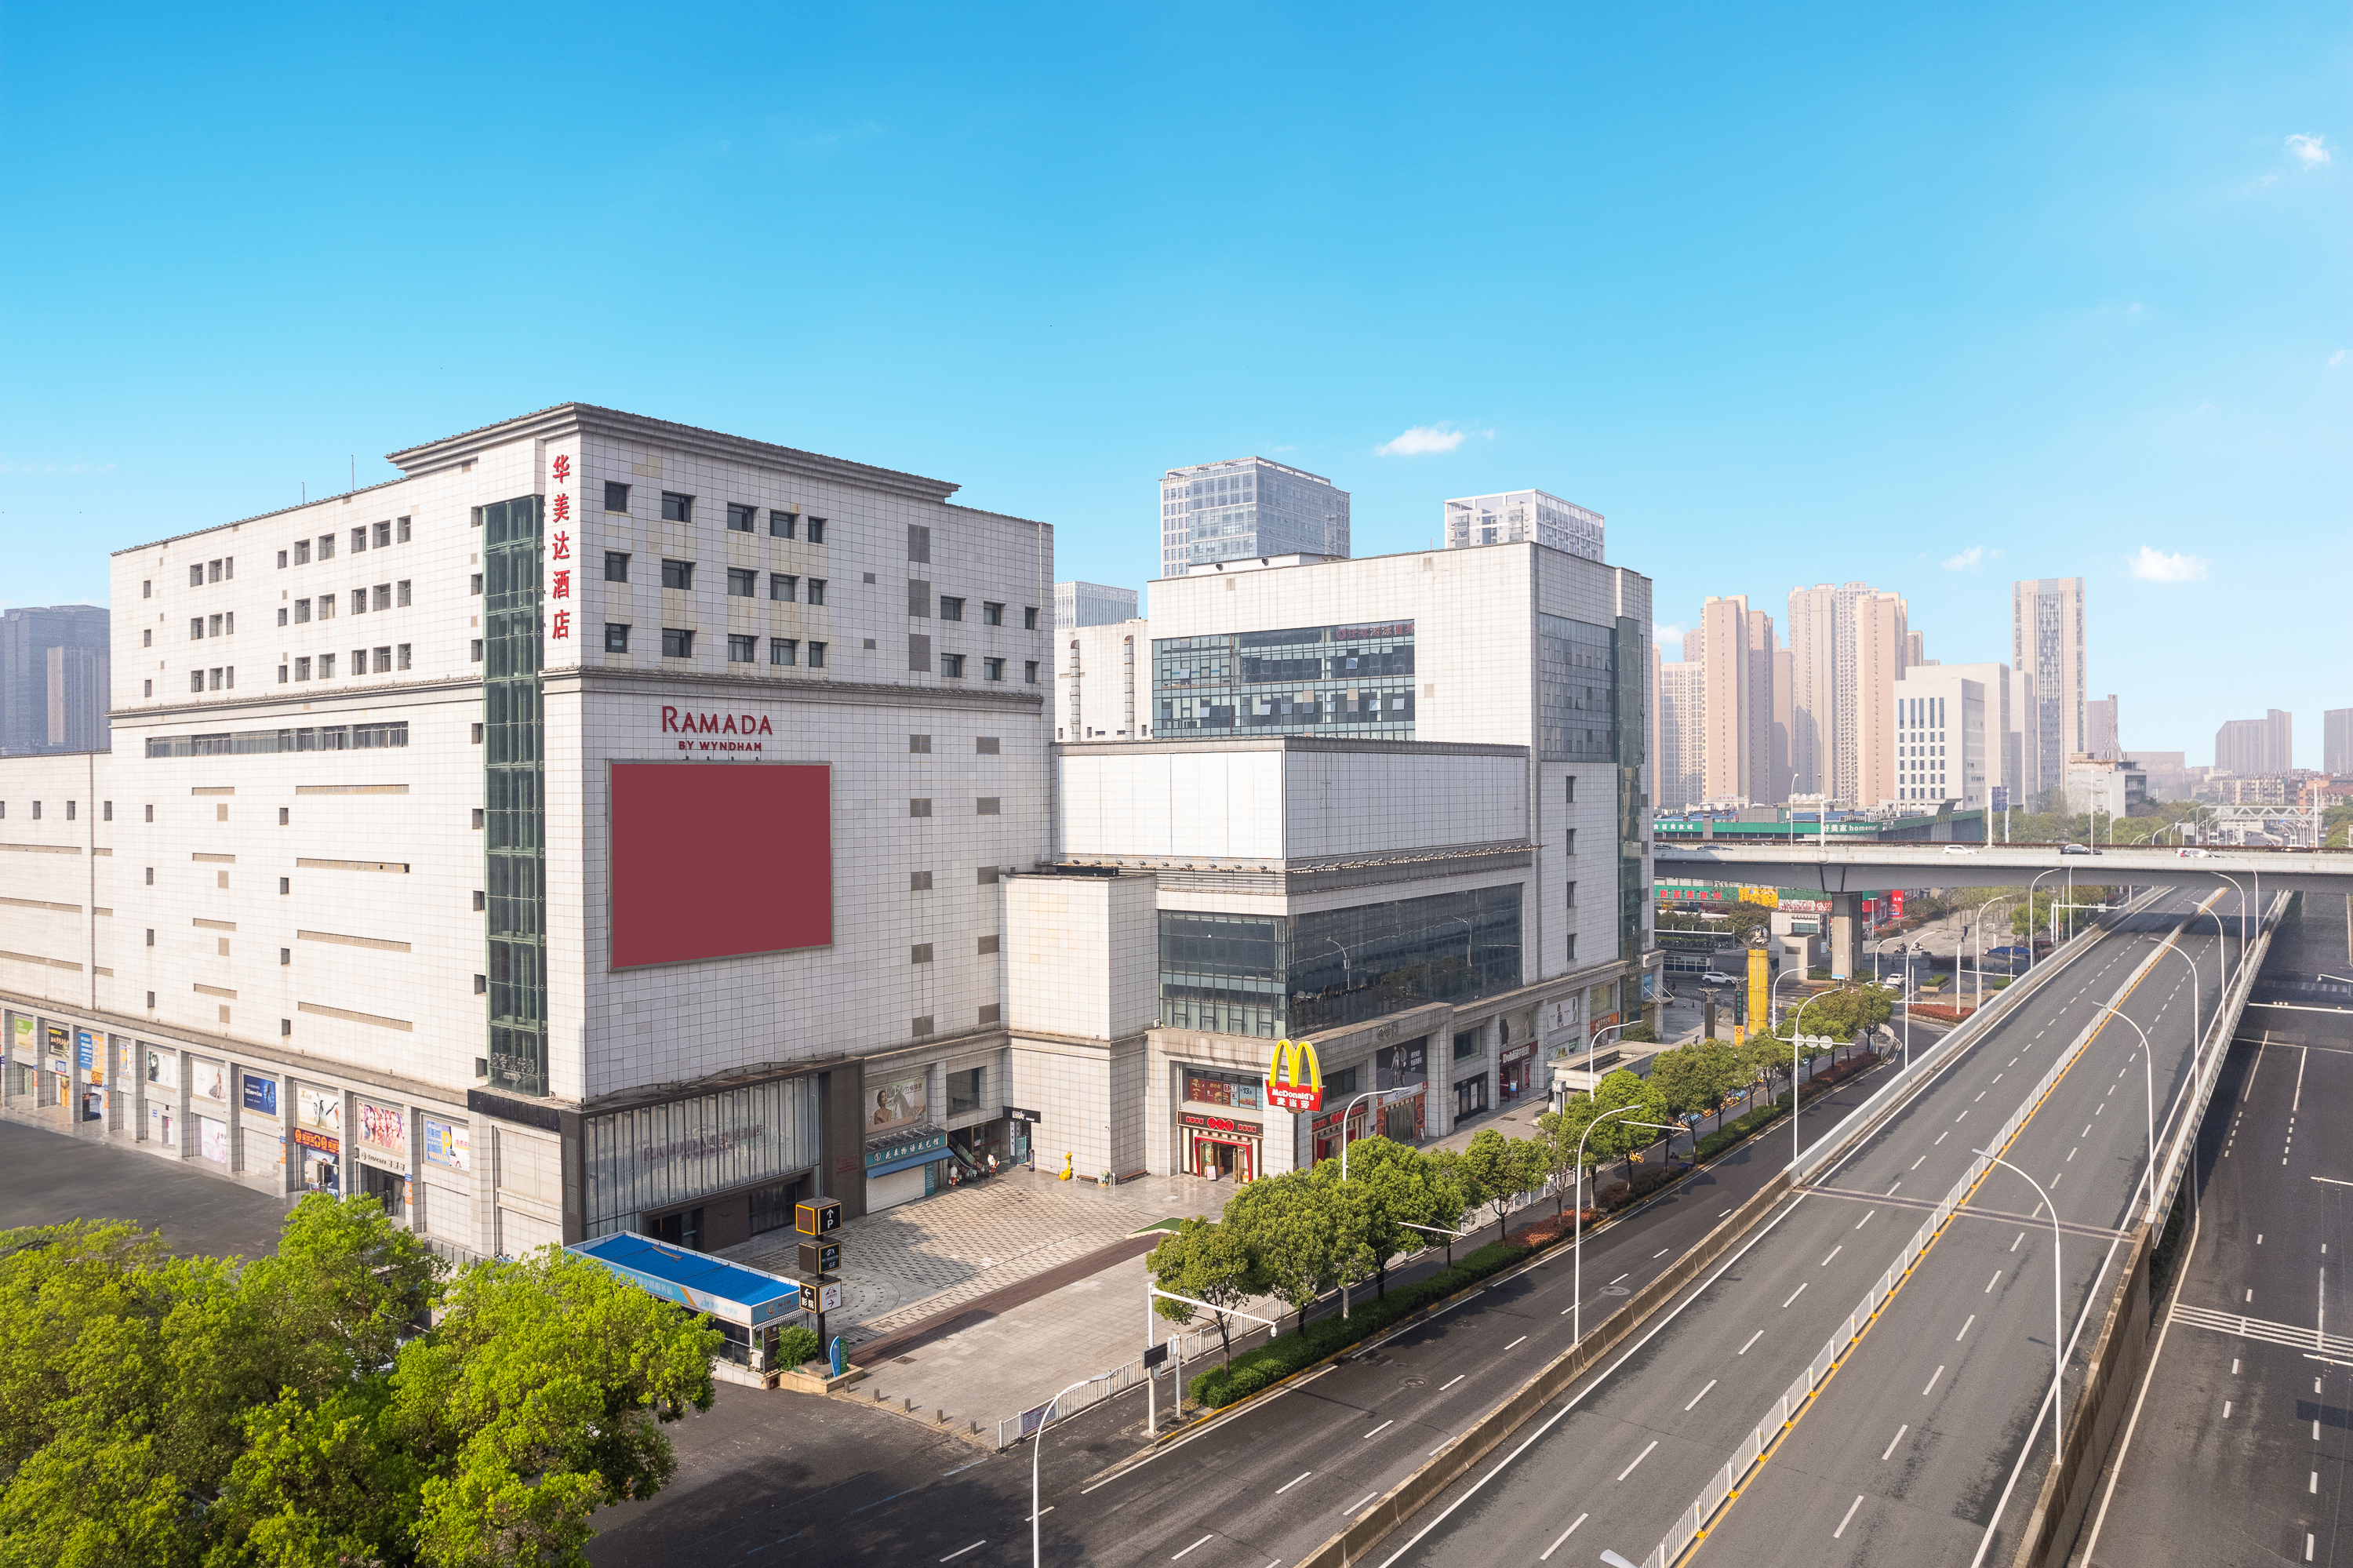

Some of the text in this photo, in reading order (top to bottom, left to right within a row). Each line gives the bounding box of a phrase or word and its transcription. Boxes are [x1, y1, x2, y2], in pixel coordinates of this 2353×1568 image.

[552, 454, 570, 639] 华美达酒店
[662, 706, 773, 735] RAMADA
[678, 740, 762, 751] BY WYNDHAM
[1271, 1089, 1315, 1101] McDonald's
[1276, 1097, 1310, 1109] 麦当劳
[442, 1131, 452, 1155] P
[827, 1219, 834, 1229] P
[801, 1297, 815, 1309] 影院
